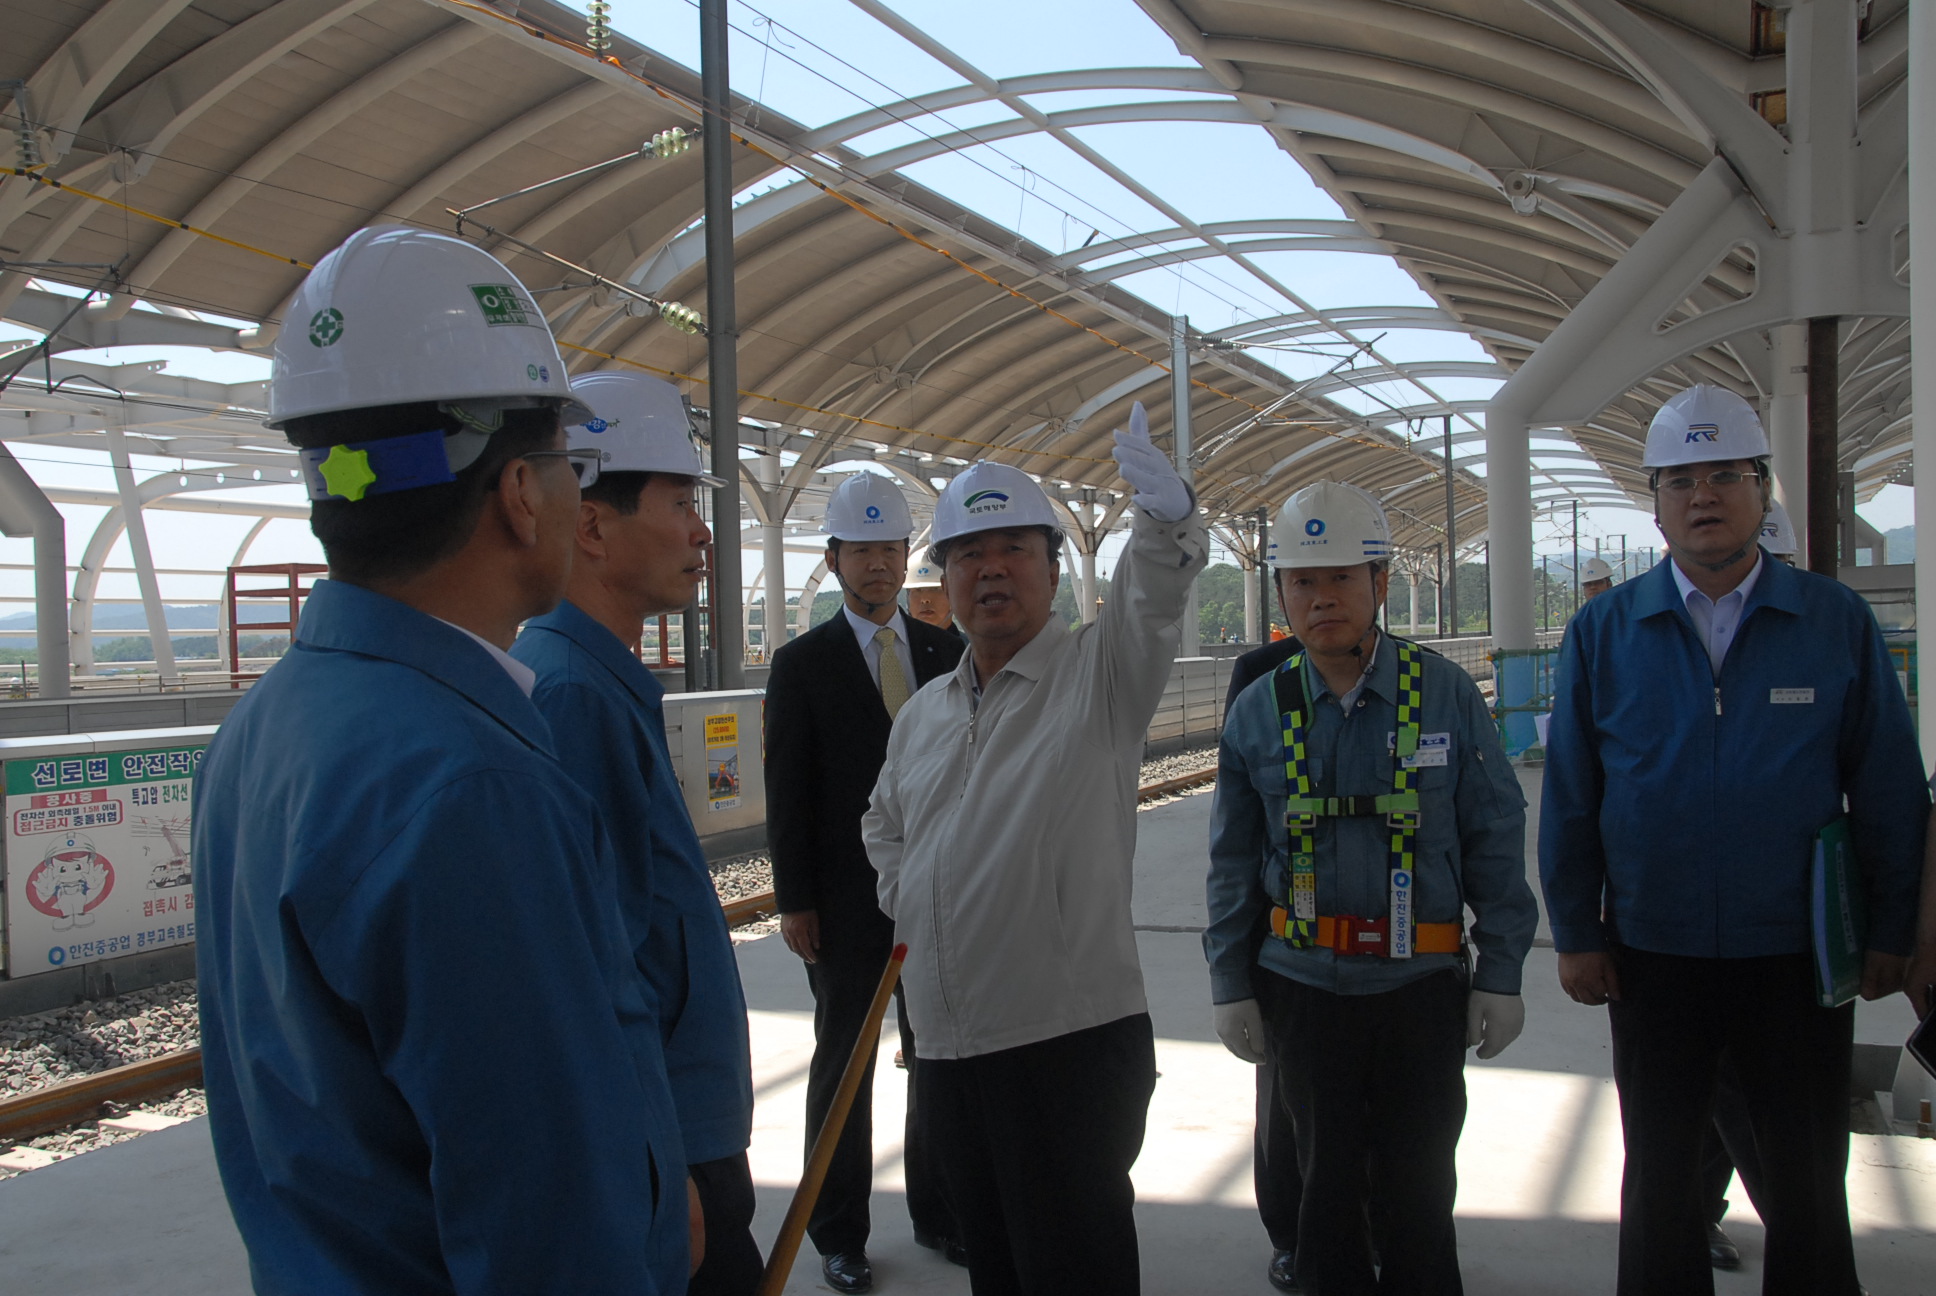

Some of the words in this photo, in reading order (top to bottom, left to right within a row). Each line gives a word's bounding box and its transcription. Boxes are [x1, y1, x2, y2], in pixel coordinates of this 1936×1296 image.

[1685, 423, 1718, 443] KR
[969, 504, 1006, 514] 국토해양부
[32, 758, 109, 787] 선로변
[46, 791, 93, 807] 공사중
[132, 786, 158, 807] 특고압
[162, 783, 188, 803] 전차선
[83, 805, 100, 813] 1.5M
[102, 803, 117, 812] 이내
[20, 817, 68, 833] 접근금지
[73, 811, 117, 827] 충돌위험
[143, 896, 178, 917] 접촉시
[1396, 890, 1407, 954] 한진중공업
[69, 935, 131, 960] 한진중공업
